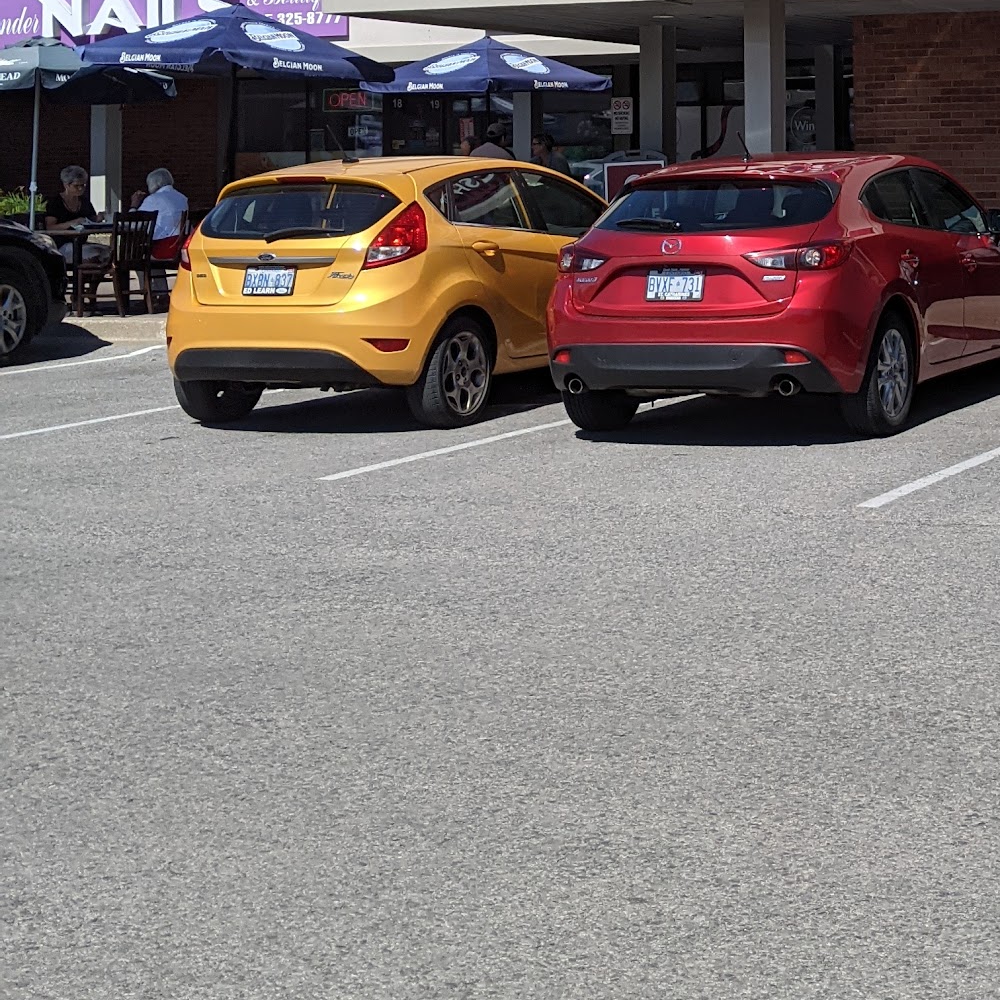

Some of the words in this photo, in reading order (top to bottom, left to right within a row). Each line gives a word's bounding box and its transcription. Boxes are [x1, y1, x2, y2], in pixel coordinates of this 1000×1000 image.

[120, 52, 145, 63] BELGIAN
[145, 53, 161, 61] MOON
[273, 57, 302, 70] BELGIAN
[303, 61, 323, 72] MOON
[329, 92, 366, 107] OPEN
[392, 98, 403, 109] 18
[430, 99, 440, 109] 19
